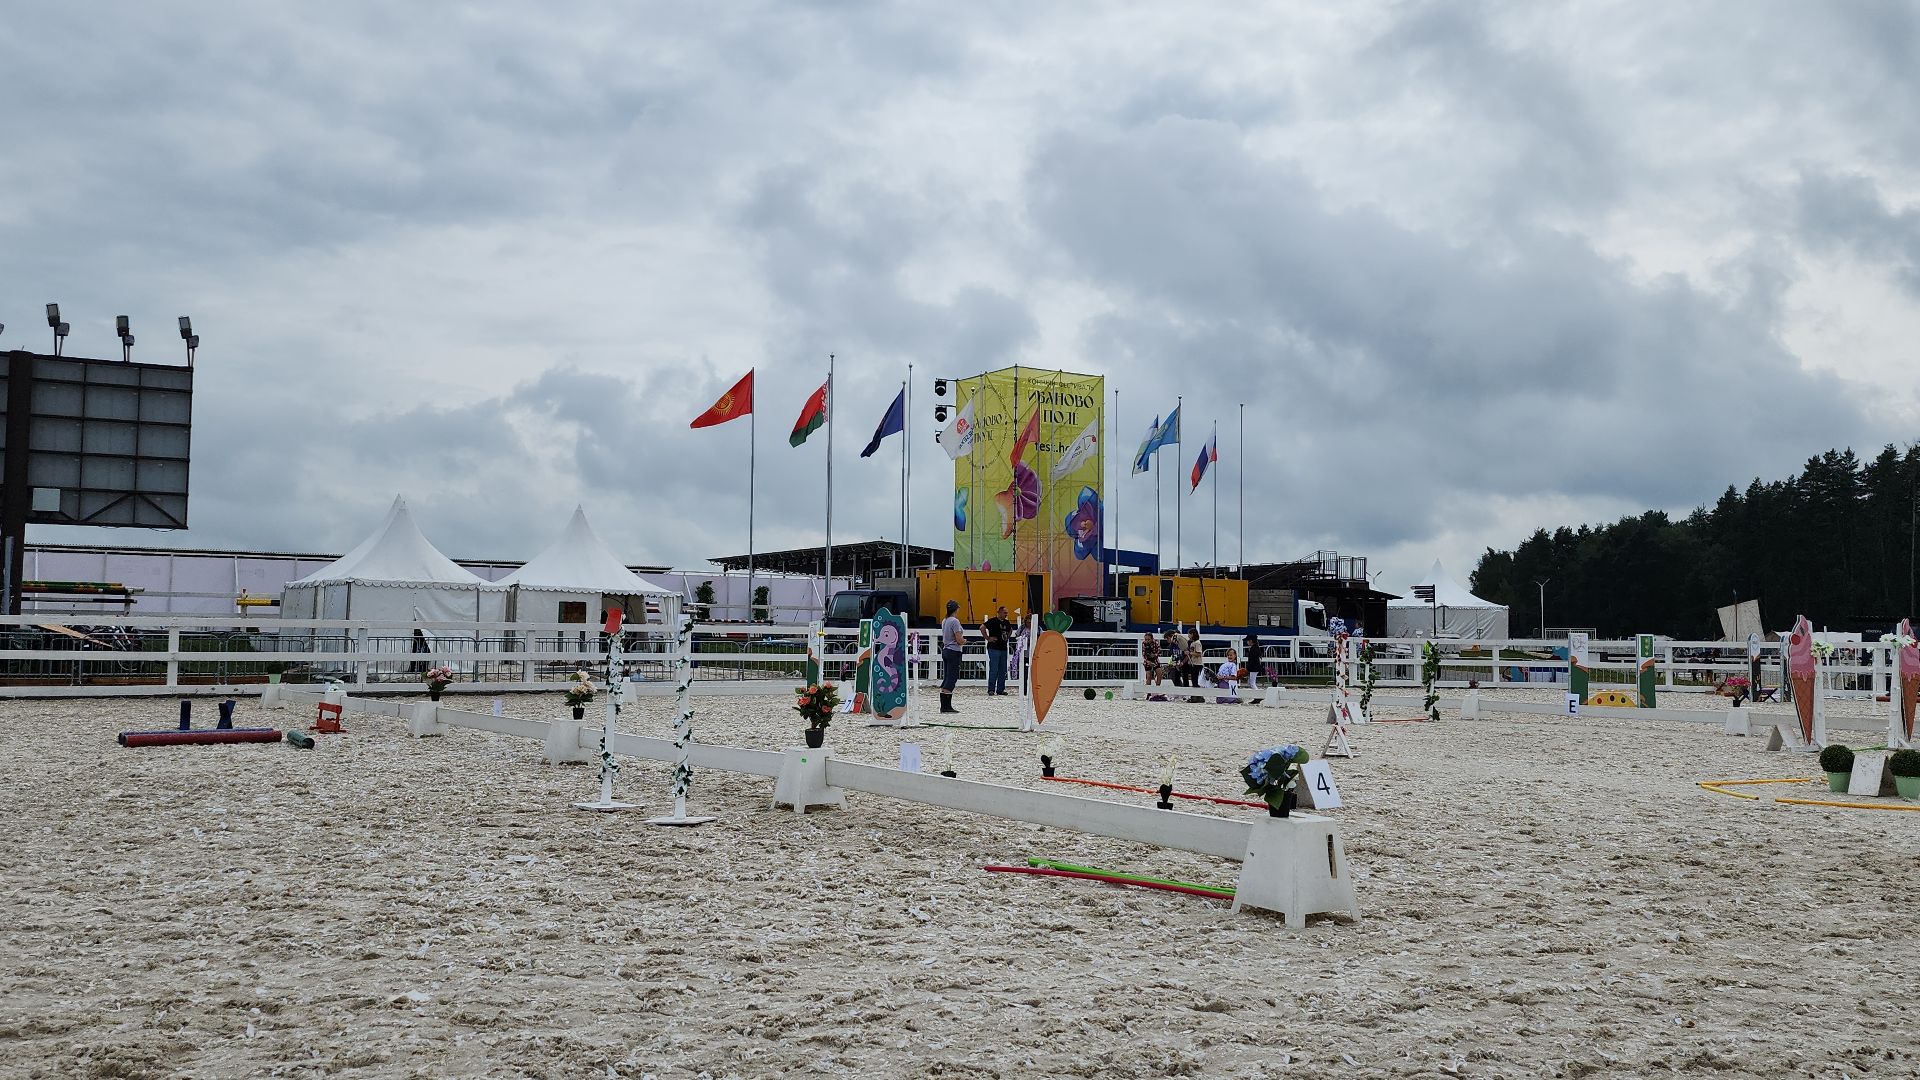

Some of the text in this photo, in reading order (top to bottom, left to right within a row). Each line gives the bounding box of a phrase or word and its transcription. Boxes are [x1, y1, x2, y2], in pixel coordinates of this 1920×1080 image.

[1028, 390, 1094, 408] ИВАНОВО
[1043, 409, 1079, 425] ПОЛЕ
[1569, 700, 1576, 713] E
[1317, 772, 1330, 795] 4
